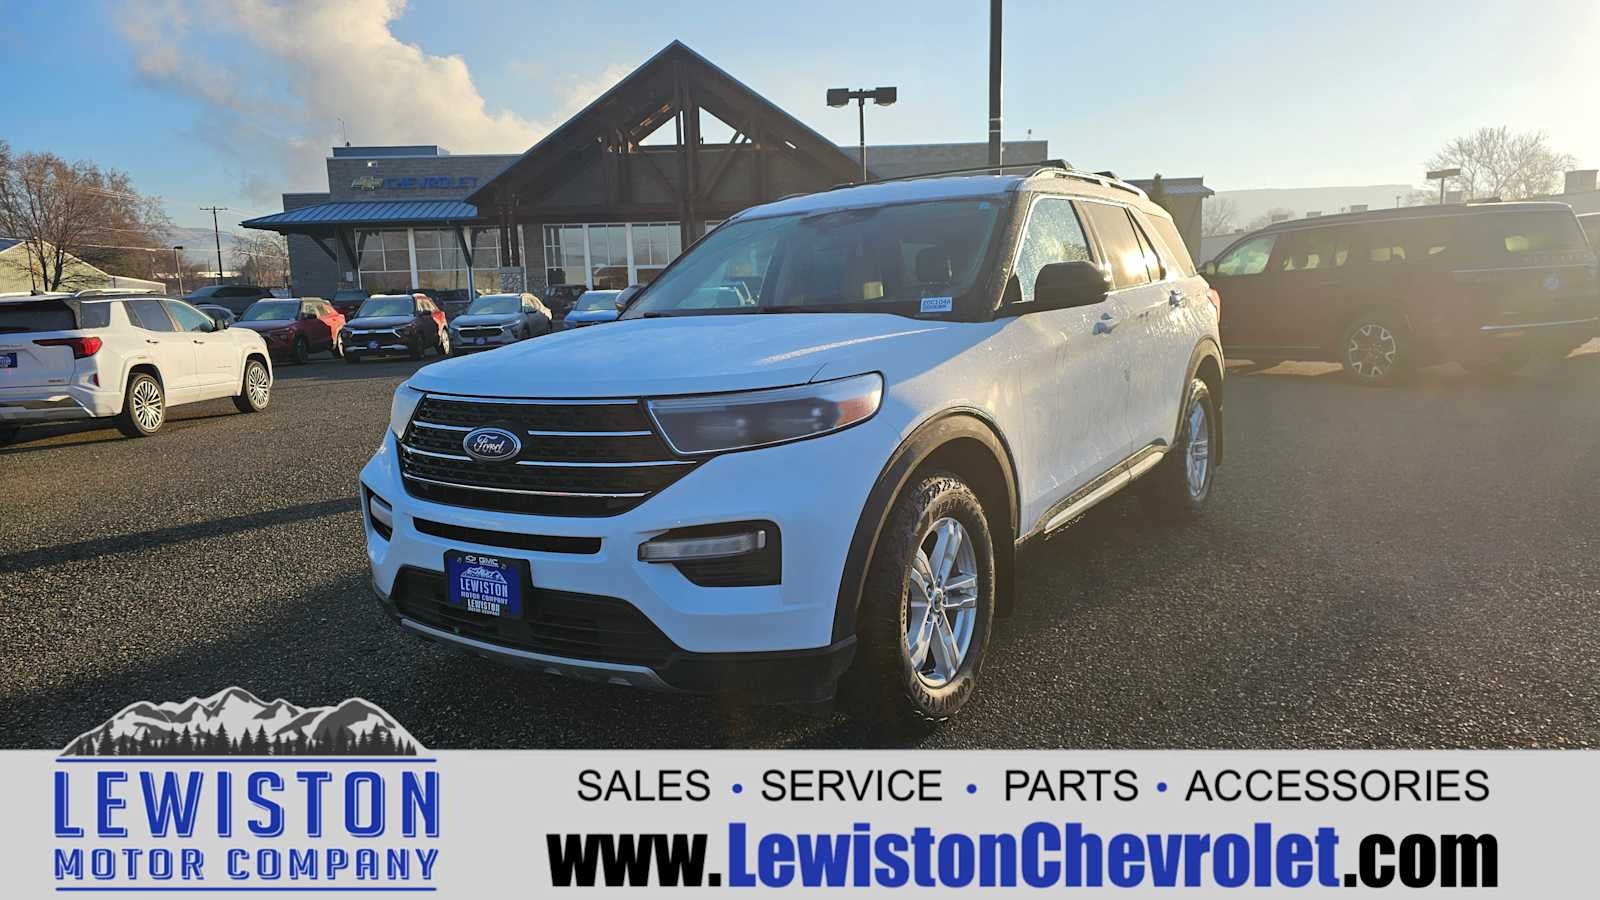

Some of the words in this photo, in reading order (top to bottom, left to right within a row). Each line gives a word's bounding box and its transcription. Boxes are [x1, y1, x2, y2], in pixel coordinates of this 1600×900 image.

[473, 434, 505, 454] Ford
[460, 577, 508, 598] LEWISTON
[461, 591, 481, 599] MOTOR
[482, 594, 508, 605] COMPANY
[467, 599, 500, 611] LEWISTON
